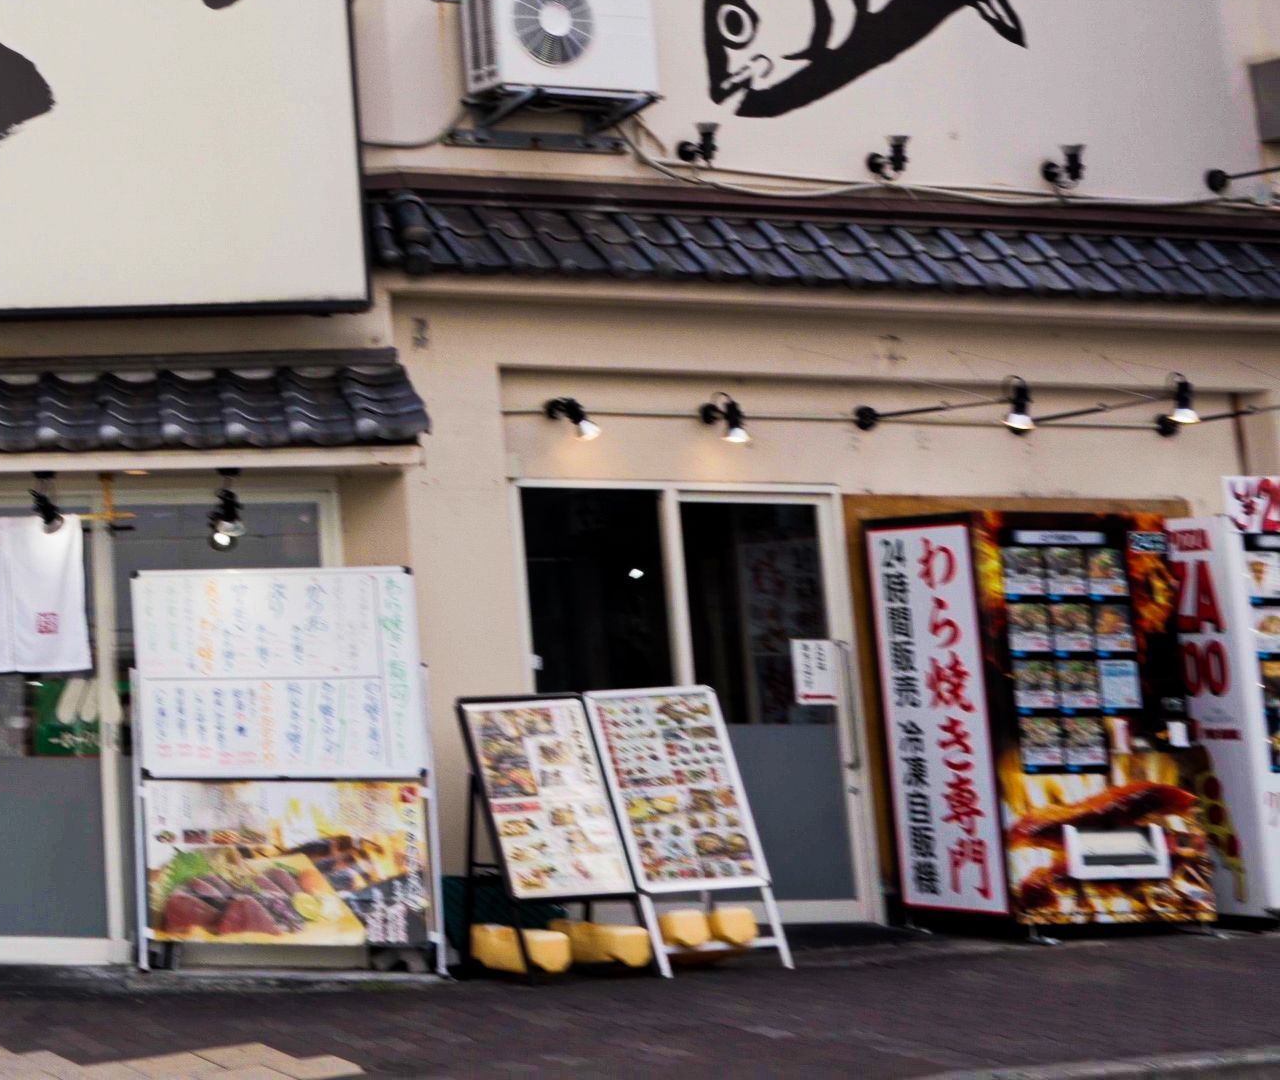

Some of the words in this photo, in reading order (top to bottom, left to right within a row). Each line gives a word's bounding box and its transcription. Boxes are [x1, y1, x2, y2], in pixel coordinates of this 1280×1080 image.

[915, 537, 995, 901] わら焼き専門
